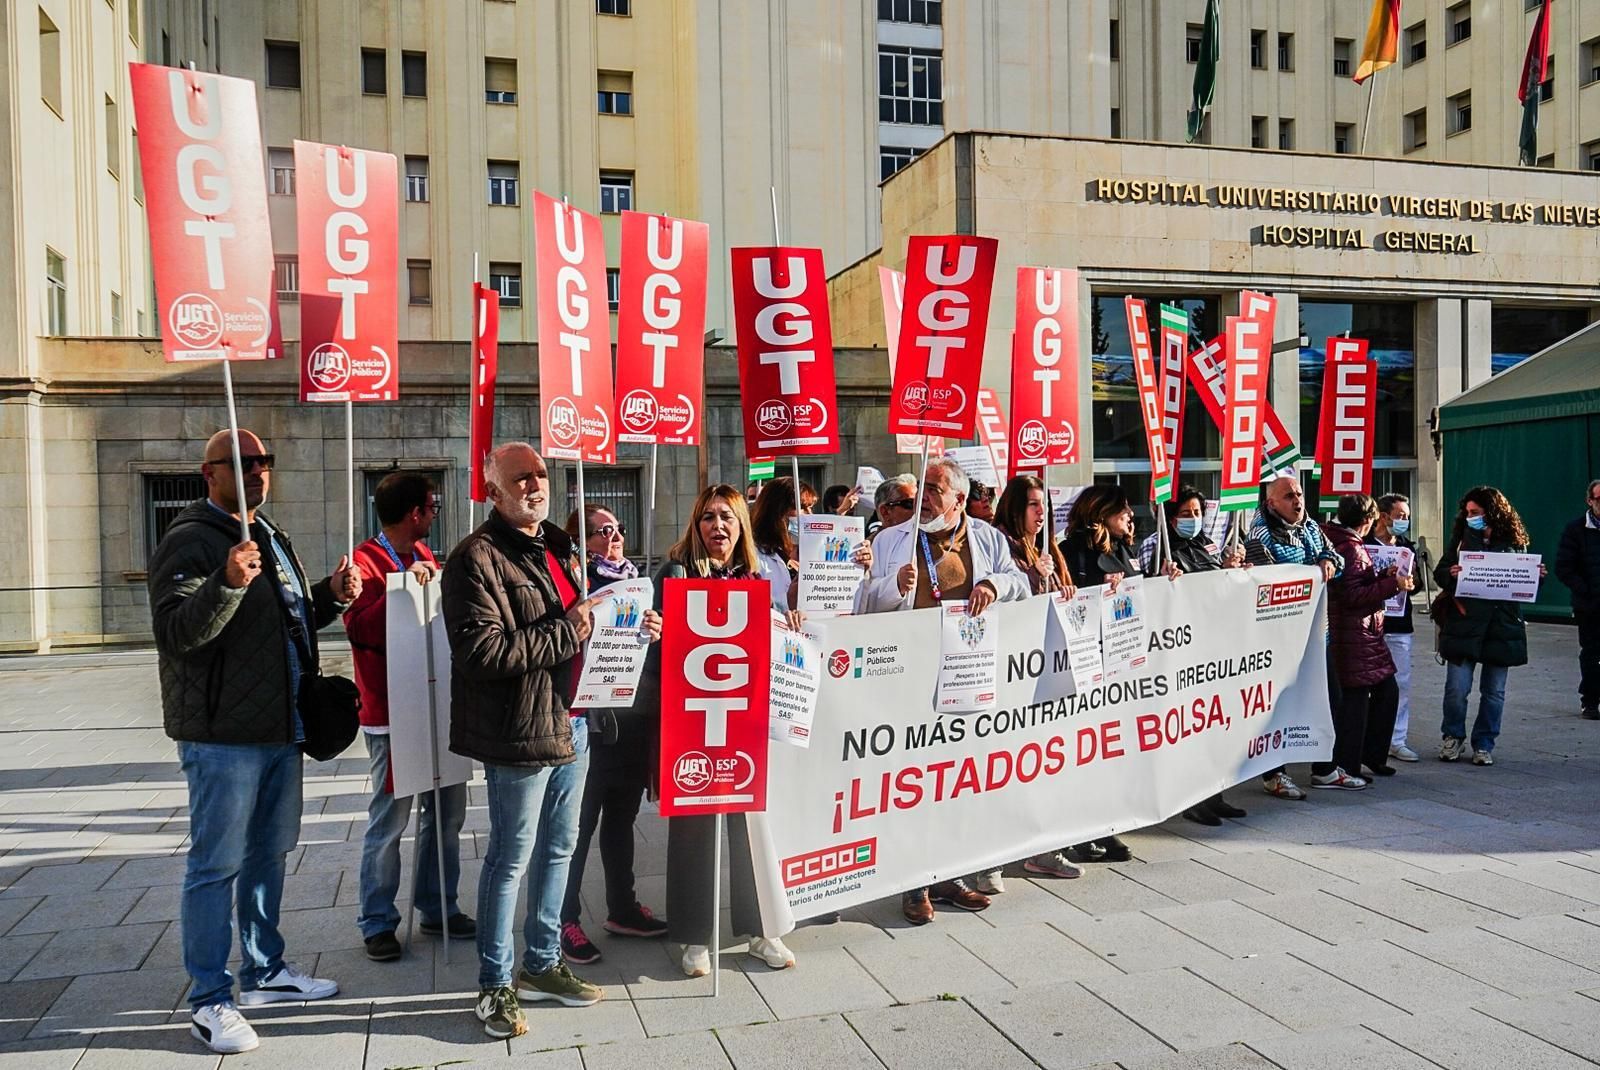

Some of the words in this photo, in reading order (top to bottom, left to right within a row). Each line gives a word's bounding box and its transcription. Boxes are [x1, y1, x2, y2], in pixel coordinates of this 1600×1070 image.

[168, 70, 237, 290] UGT
[1098, 178, 1209, 203] HOSPITAL
[1218, 186, 1381, 212] UNIVERSITARIO
[1389, 195, 1461, 217] VIRGEN
[1470, 200, 1493, 219] DE
[1500, 202, 1534, 221] LAS
[1544, 204, 1600, 224] NIEVE
[325, 147, 370, 340] UGT
[1263, 224, 1372, 249] HOSPITAL
[1385, 229, 1481, 253] GENERAL
[554, 201, 590, 397] UGT
[642, 216, 683, 388] UGT
[177, 304, 215, 323] UGT
[915, 245, 978, 379] UGT
[752, 257, 815, 395] UGT
[1033, 269, 1062, 417] UGT
[314, 352, 345, 370] UGT
[351, 359, 385, 369] Servicios
[904, 387, 926, 400] UGT
[1131, 304, 1166, 474] CCOO
[627, 397, 652, 414] UGT
[659, 405, 689, 415] Servicios
[760, 405, 785, 421] UGT
[1230, 322, 1259, 485] CCOO
[552, 405, 576, 425] UGT
[1023, 427, 1044, 441] UGT
[1332, 364, 1367, 492] CCOO
[806, 594, 844, 602] profesionales
[1273, 584, 1304, 601] CCOO
[600, 628, 614, 637] 7.000
[591, 641, 611, 650] 300.000
[611, 643, 621, 651] por
[866, 645, 898, 654] Servicios
[683, 590, 749, 747] UGT
[866, 655, 895, 665] Públicos
[1007, 648, 1045, 682] NO
[589, 666, 624, 674] profesionales
[866, 664, 904, 677] Andalucía
[785, 680, 795, 688] por
[771, 688, 795, 700] Respeto
[842, 724, 895, 762] NO
[905, 715, 965, 750] MÁS
[974, 675, 1169, 738] CONTRATACIONES
[1176, 649, 1273, 692] IRREGULARES
[1248, 732, 1271, 759] UGT
[832, 735, 1066, 834] ¡LISTADOS
[1076, 720, 1125, 766] DE
[1136, 694, 1231, 752] BOLSA,
[1240, 680, 1273, 719] YA!
[680, 759, 707, 776] UGT
[786, 848, 854, 882] CCOO
[795, 886, 805, 894] de
[807, 876, 837, 891] sanidad
[844, 867, 876, 880] sectores
[824, 881, 861, 897] Andalucía
